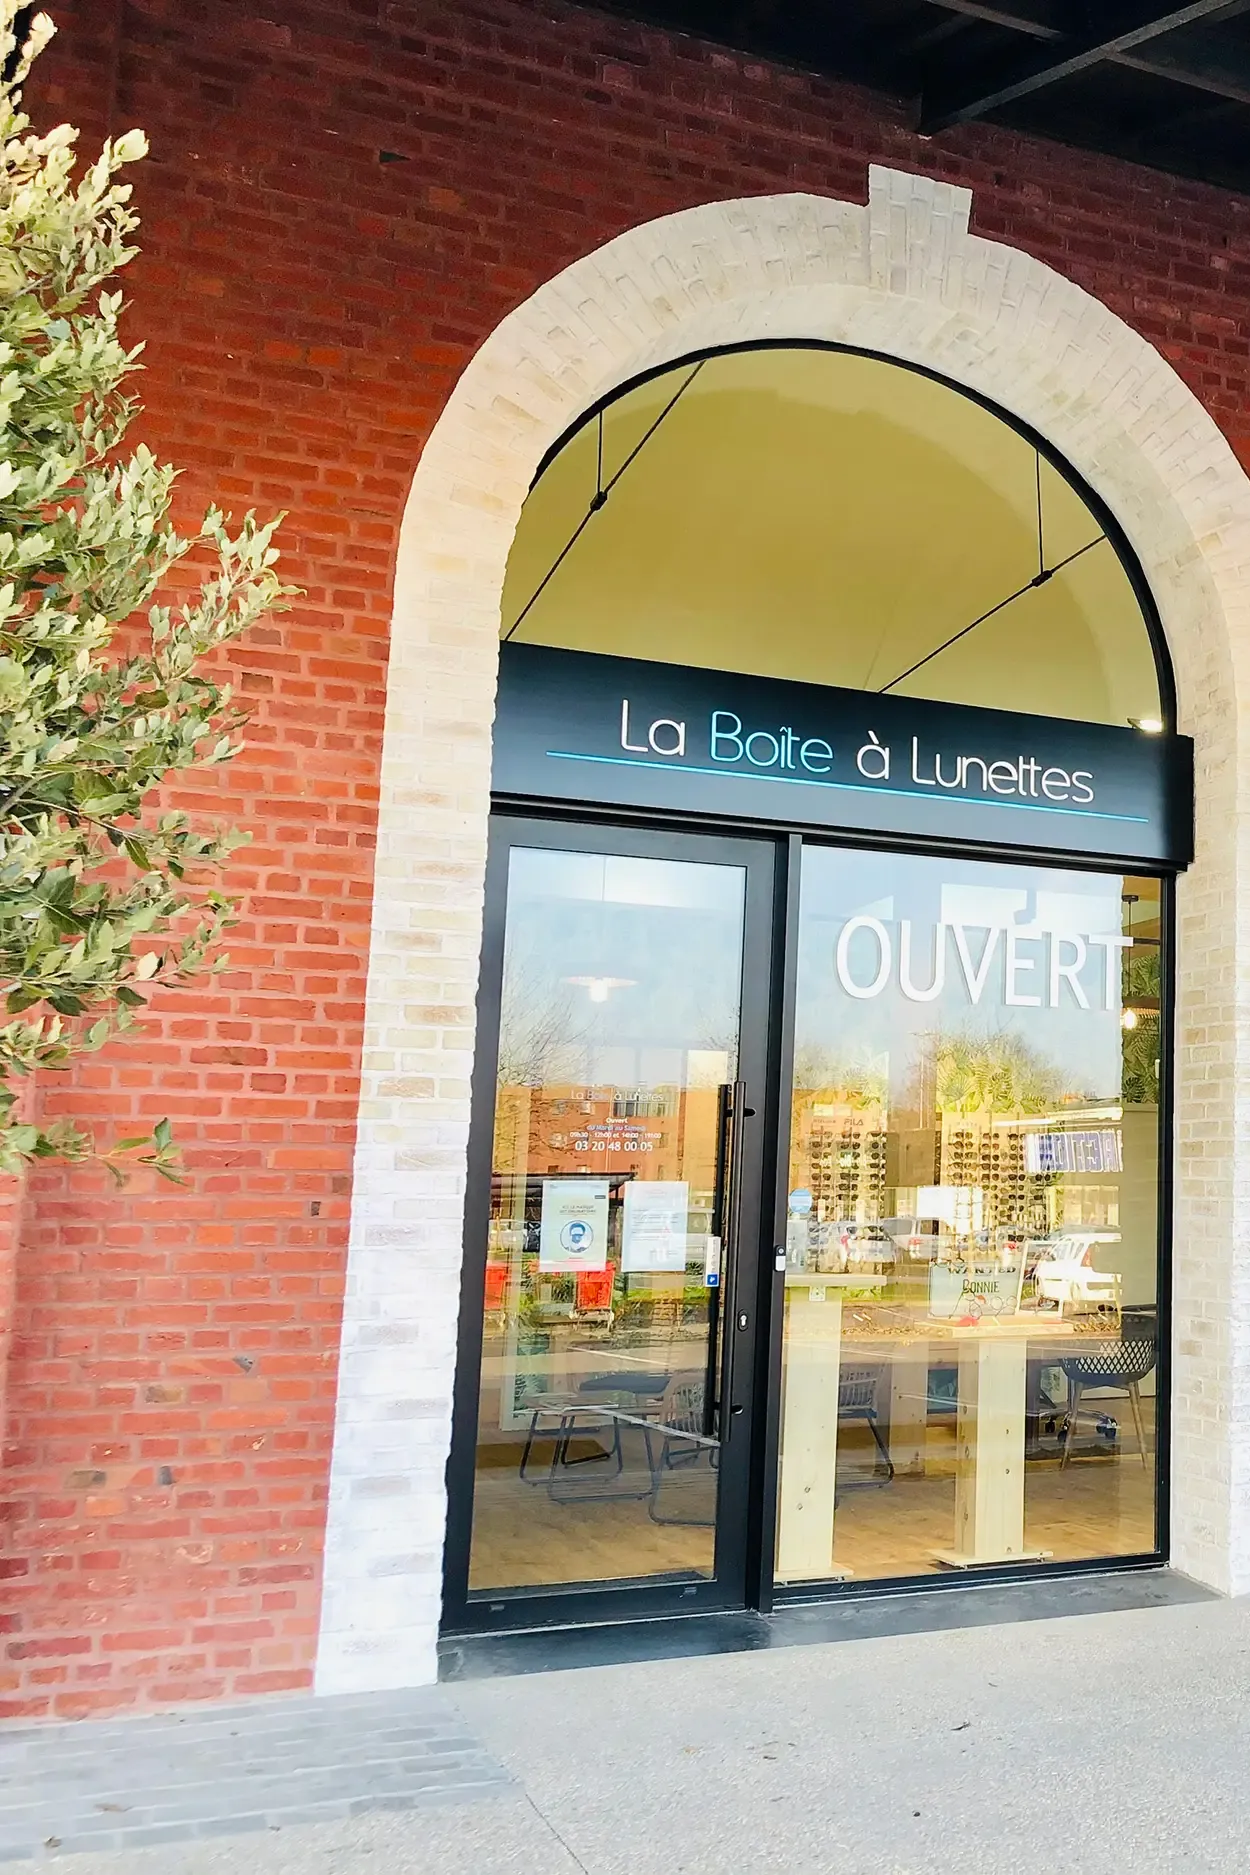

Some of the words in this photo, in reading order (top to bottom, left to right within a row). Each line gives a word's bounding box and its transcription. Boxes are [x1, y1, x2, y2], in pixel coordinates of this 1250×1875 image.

[620, 698, 686, 757] La
[710, 710, 834, 774] Boîte
[856, 730, 890, 782] à
[912, 735, 1095, 804] Lunettes
[836, 914, 1134, 1011] OUVERT
[843, 1117, 864, 1126] FILA
[575, 1141, 588, 1151] 03
[591, 1141, 605, 1151] 20
[608, 1141, 621, 1151] 48
[624, 1141, 638, 1151] 00
[640, 1141, 653, 1152] 05
[962, 1278, 1000, 1294] BONNIE
